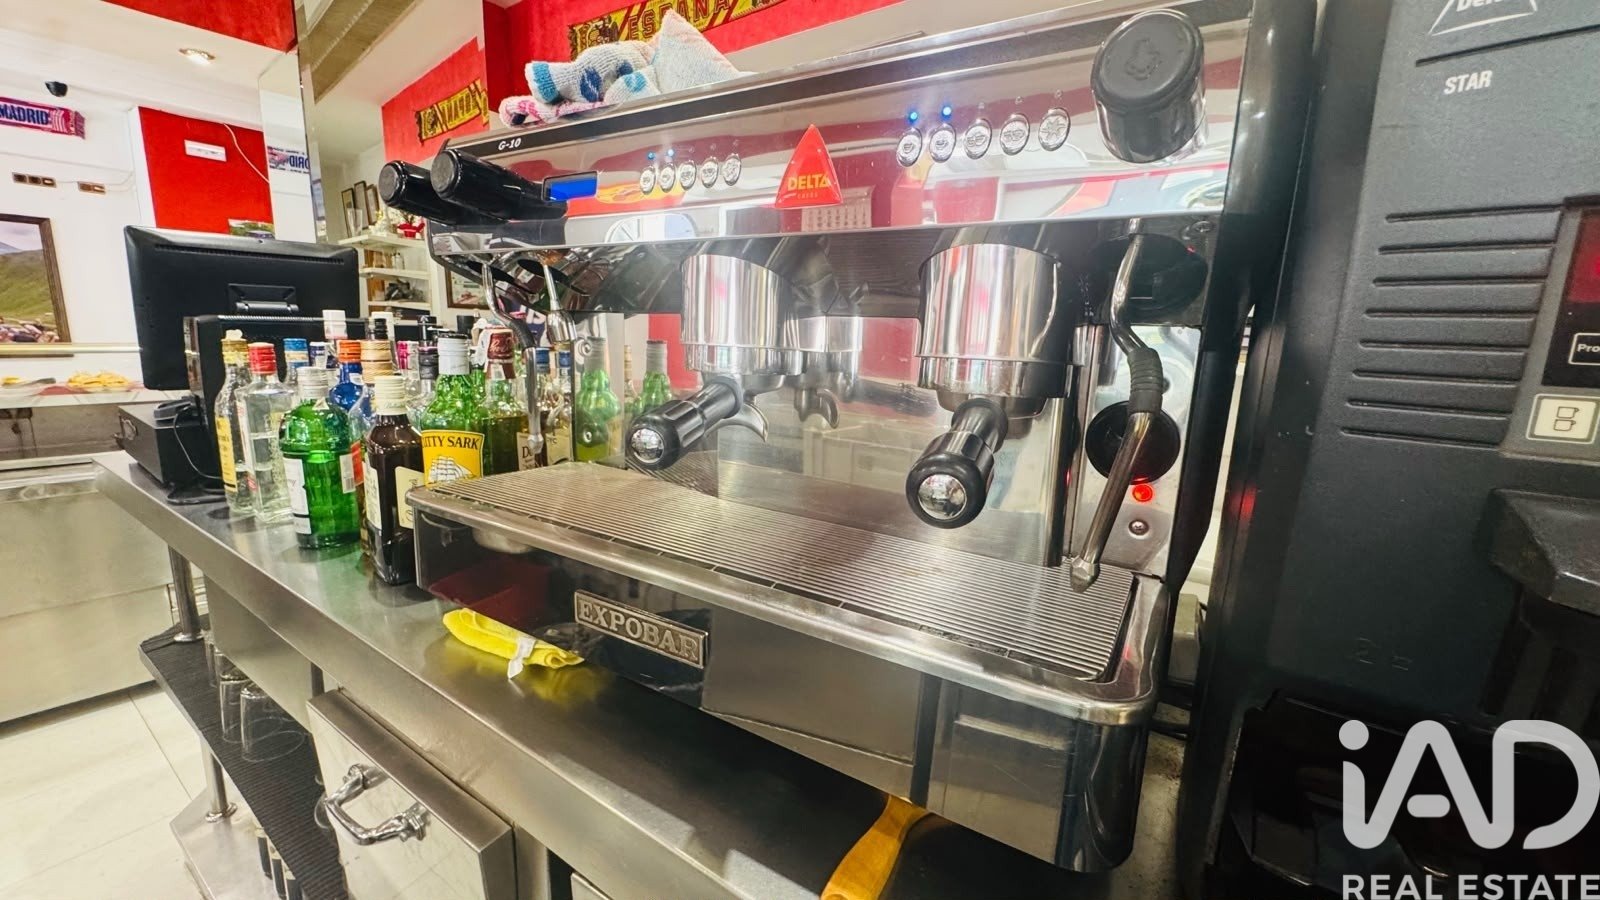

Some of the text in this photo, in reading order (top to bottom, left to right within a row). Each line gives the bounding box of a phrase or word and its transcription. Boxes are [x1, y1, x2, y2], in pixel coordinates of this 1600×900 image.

[1444, 70, 1493, 95] STAR
[0, 103, 49, 126] MADRID
[498, 138, 522, 150] G-10
[787, 173, 832, 191] DELTA
[447, 436, 480, 450] SARK
[578, 601, 698, 662] EXPOBAR
